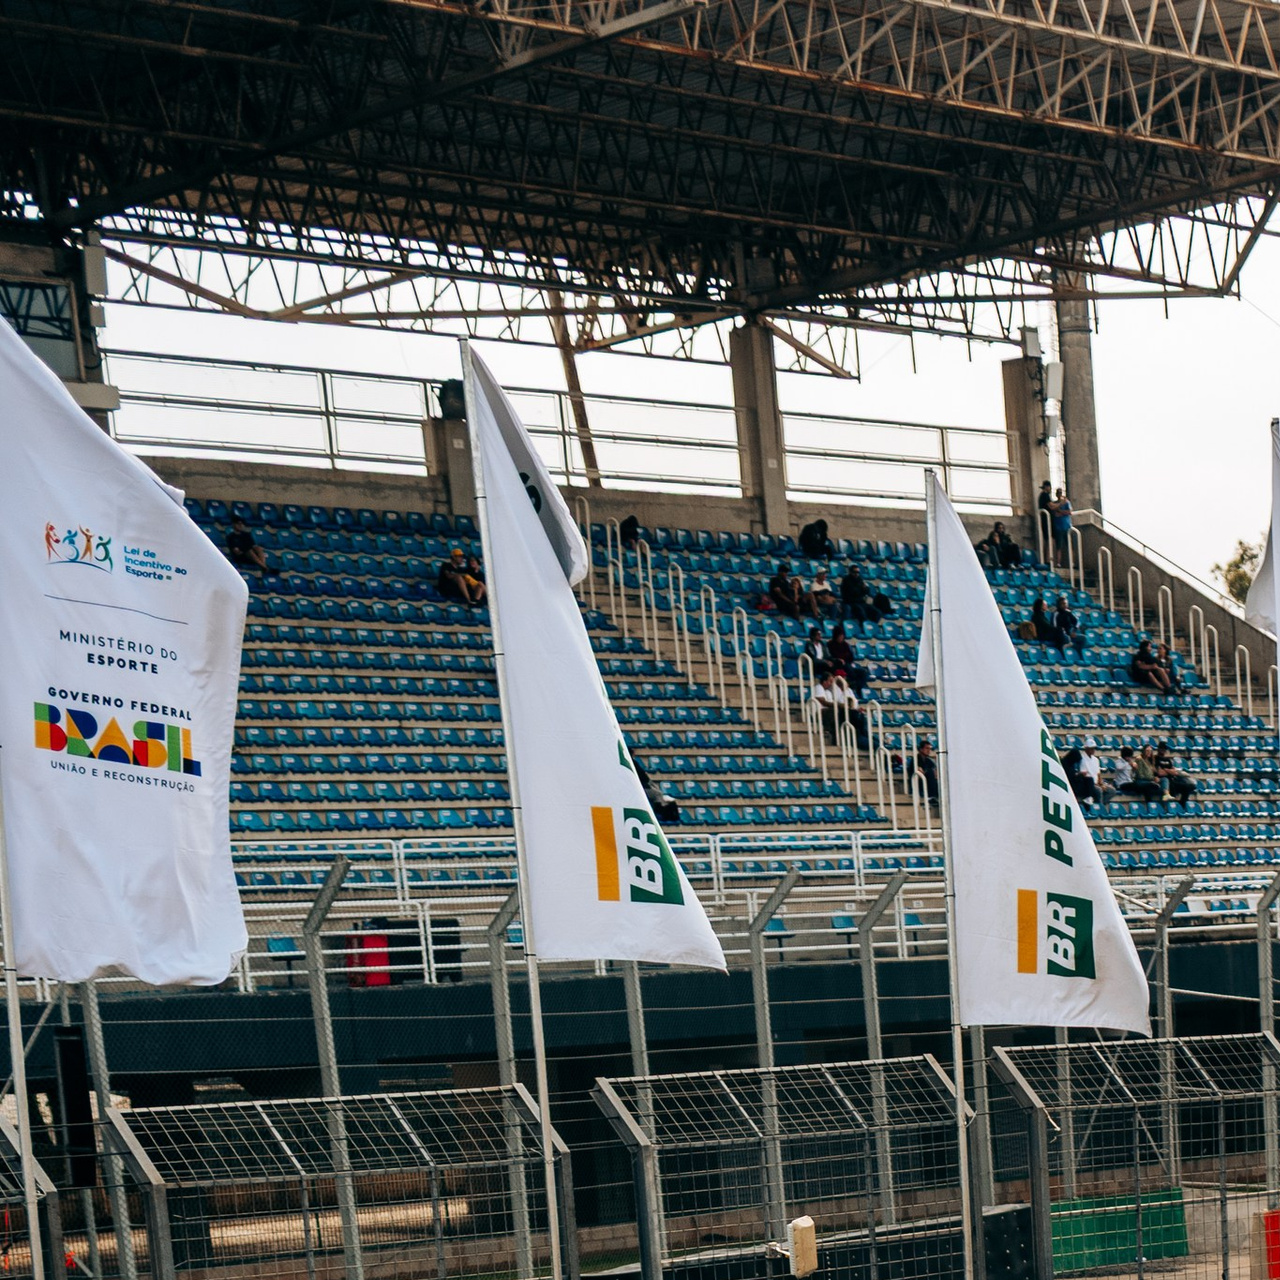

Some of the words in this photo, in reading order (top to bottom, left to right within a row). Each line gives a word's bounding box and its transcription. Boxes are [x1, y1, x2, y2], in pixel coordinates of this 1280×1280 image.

[124, 546, 140, 556] Lei
[143, 549, 156, 559] de
[124, 556, 172, 571] Incentivo
[174, 567, 187, 576] ao
[125, 565, 164, 580] Esporte
[59, 629, 155, 656] MINISTÉRIO
[160, 647, 178, 661] DO
[86, 652, 159, 675] ESPORTE
[48, 686, 124, 709] GOVERNO
[130, 700, 192, 722] FEDERAL
[33, 701, 203, 778] BRASIL
[50, 759, 87, 775] UNIÃO
[92, 768, 99, 778] E
[103, 769, 196, 794] RECONSTRUÇÃO
[623, 815, 668, 898] BR
[1046, 897, 1080, 974] BR
